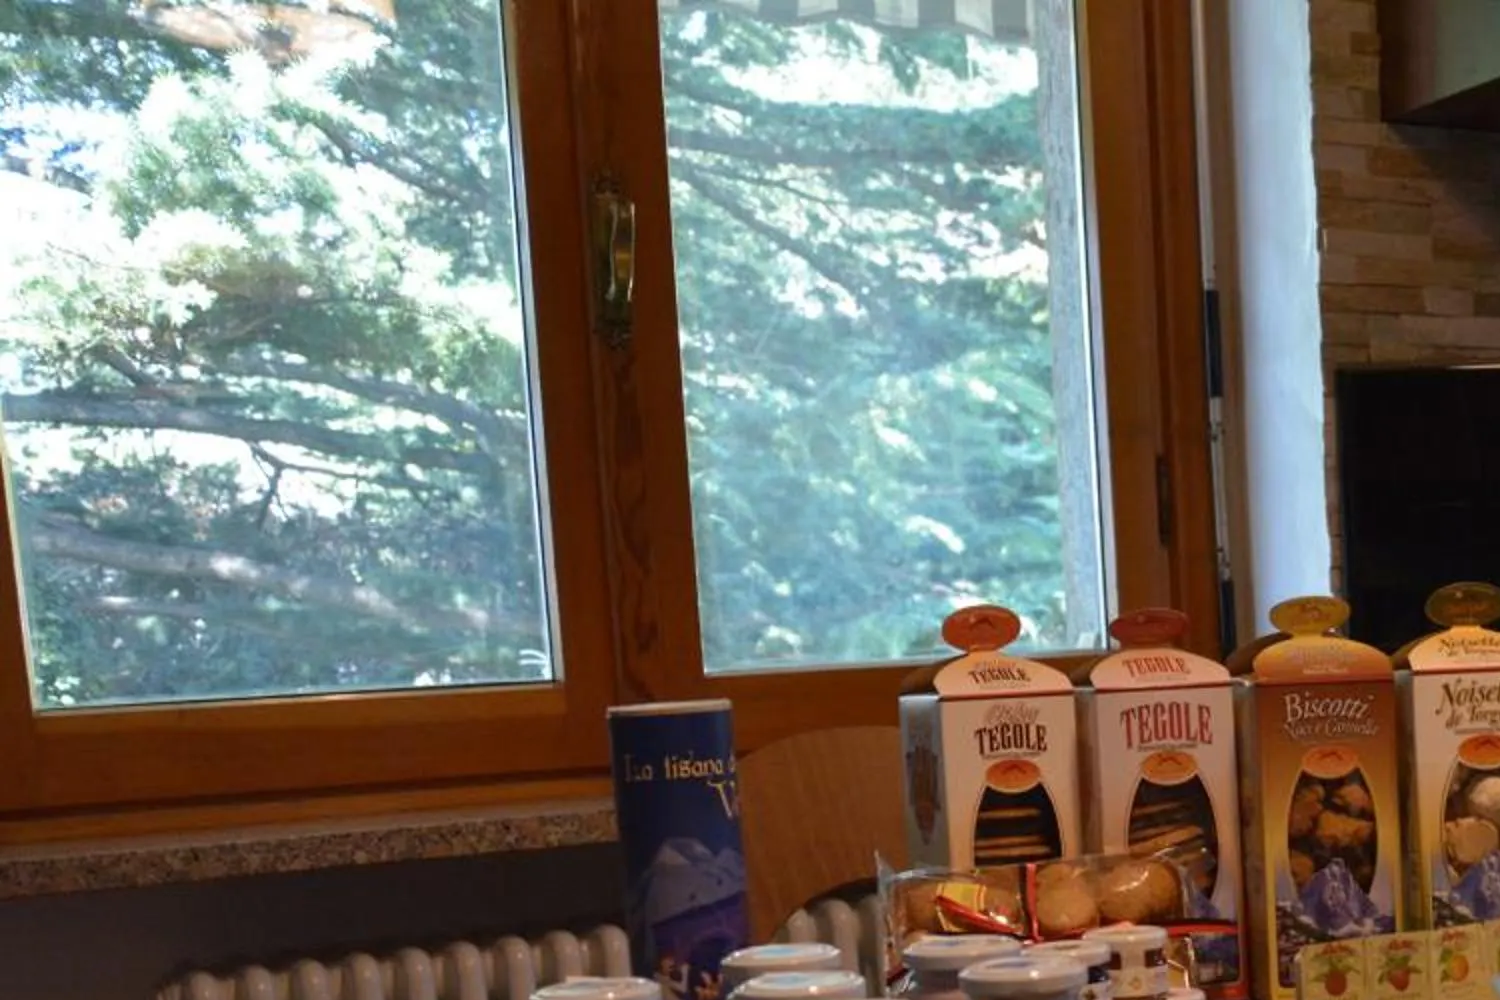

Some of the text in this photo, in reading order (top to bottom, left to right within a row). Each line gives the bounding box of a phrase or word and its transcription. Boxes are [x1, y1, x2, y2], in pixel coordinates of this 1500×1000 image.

[968, 667, 1031, 685] TEGOLE
[1121, 655, 1191, 679] TEGOLE
[1282, 690, 1376, 723] Biscotti
[974, 721, 1048, 755] TEGOLE
[1120, 701, 1213, 750] TEGOLE
